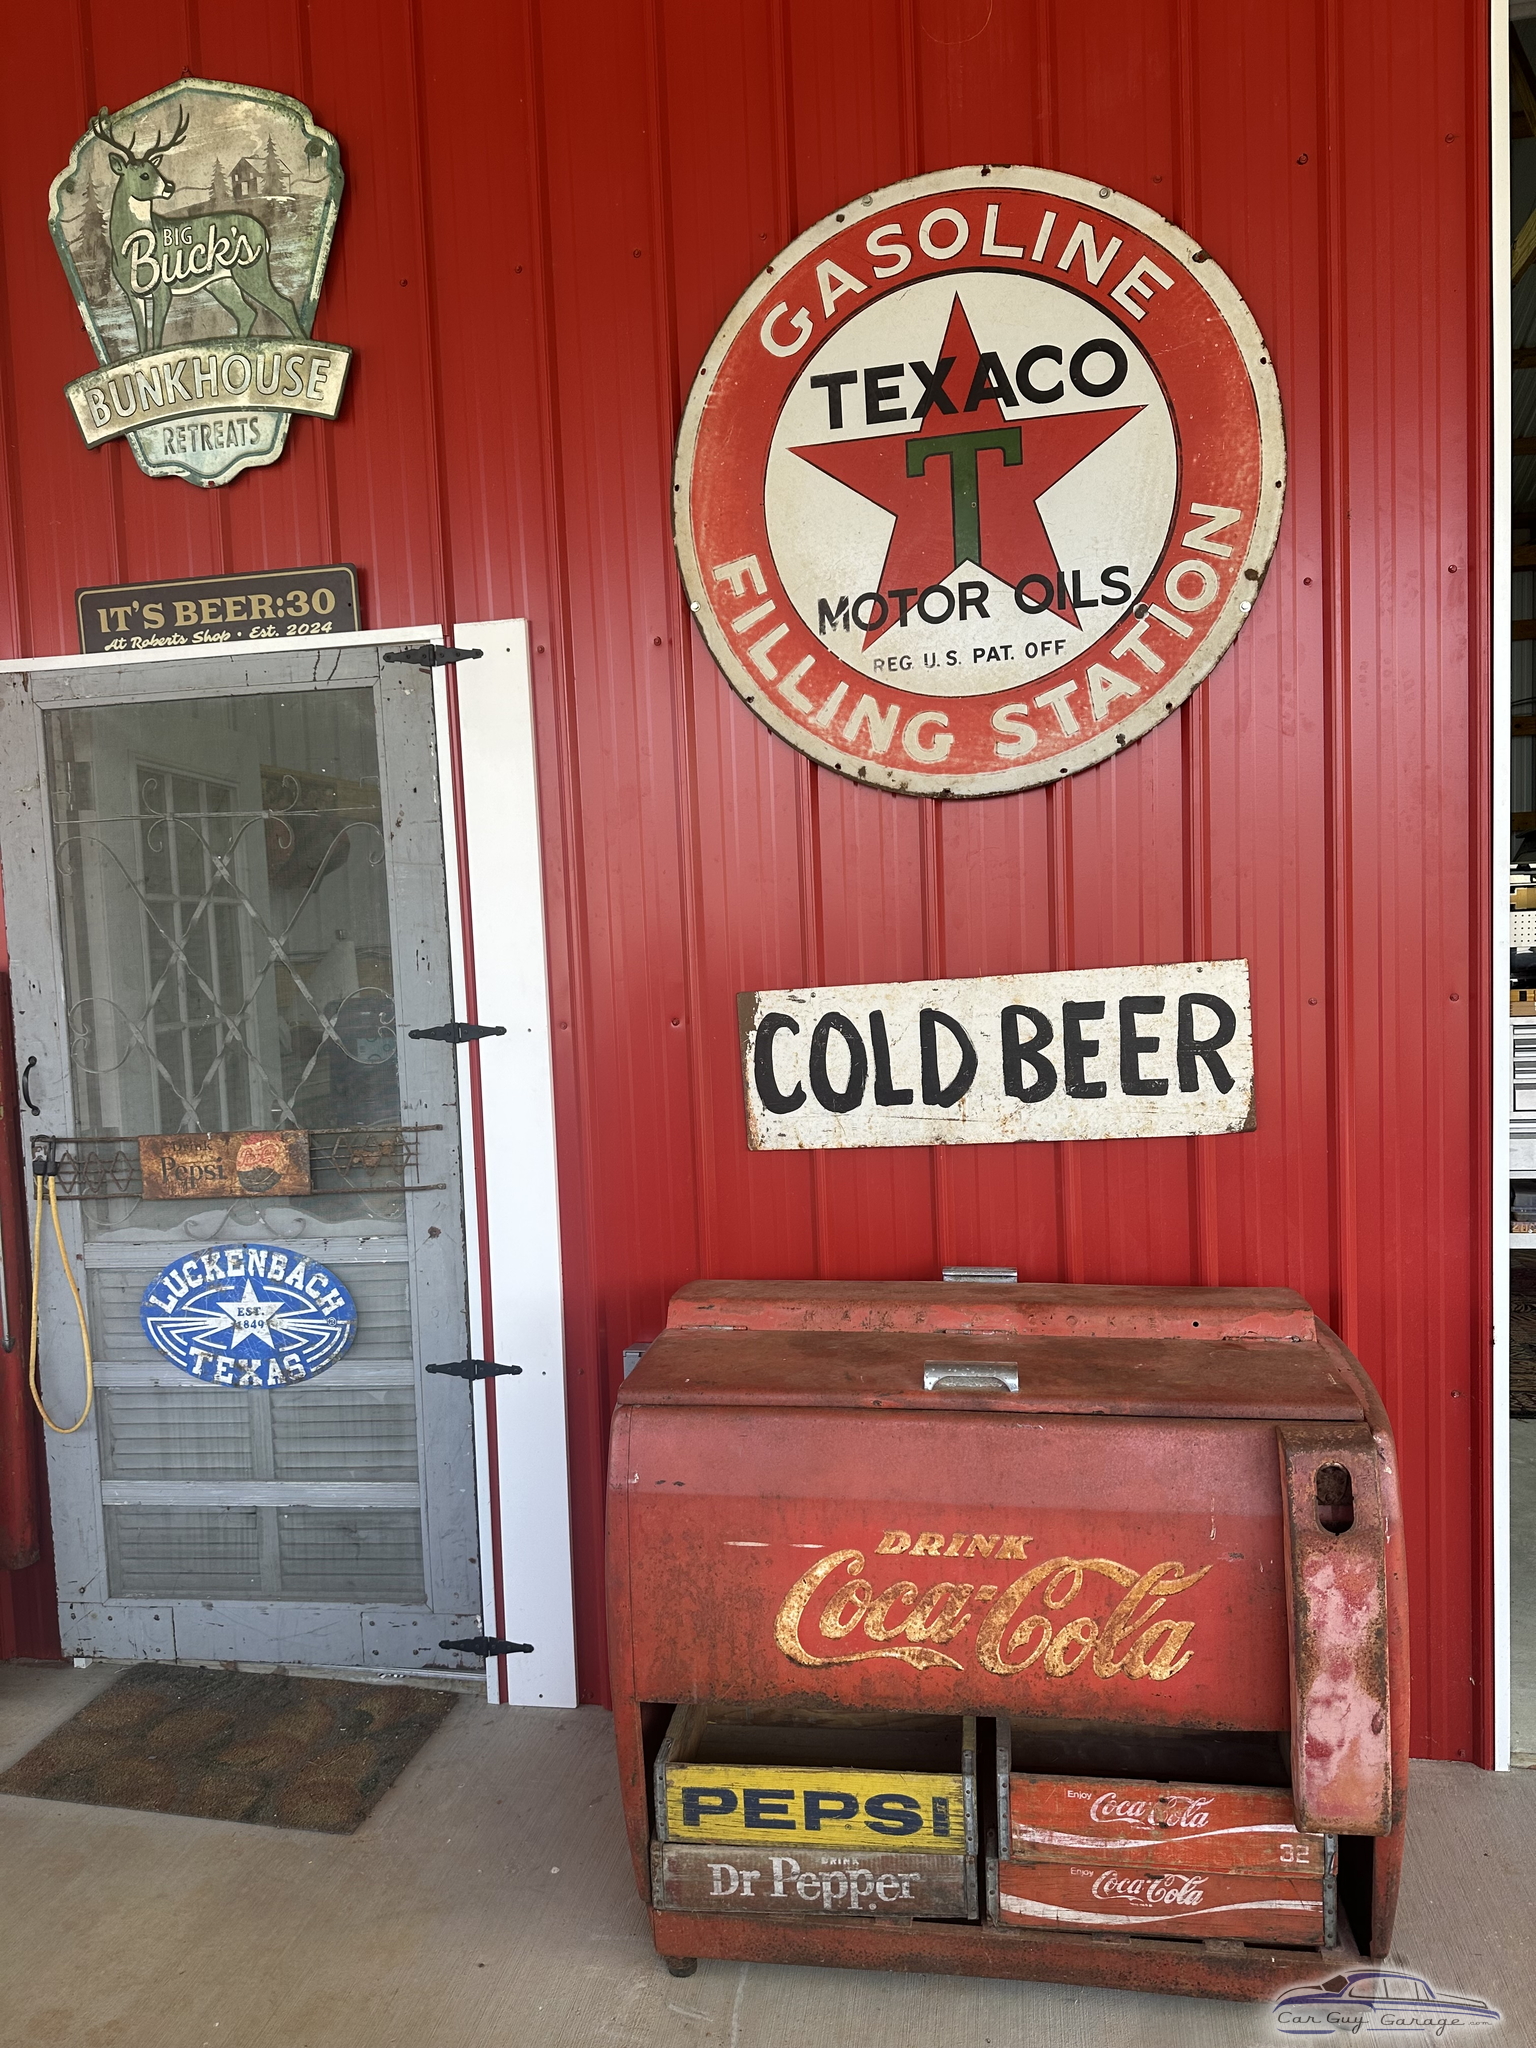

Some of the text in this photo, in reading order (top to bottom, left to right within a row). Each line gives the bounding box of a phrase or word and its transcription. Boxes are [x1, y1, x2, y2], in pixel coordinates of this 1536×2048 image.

[162, 226, 192, 247] BIG
[121, 224, 262, 294] Buck's
[759, 204, 1175, 359] GASOLINE
[85, 353, 331, 429] BUNKHOUSE
[810, 338, 1129, 430] TEXACO
[163, 417, 260, 456] RETREATS
[905, 426, 1023, 571] T
[97, 588, 336, 633] IT'S BEER:30
[817, 566, 1133, 637] MOTOR OILS
[104, 621, 333, 651] At Roberts Shop Est. 2024
[712, 502, 1243, 763] FILLING STATION
[973, 645, 1014, 663] PAT.
[1025, 639, 1067, 658] OFF
[755, 993, 1236, 1114] COLD BEER
[160, 1156, 227, 1189] Pepsi
[150, 1249, 345, 1316] LUCKENBACH
[237, 1307, 265, 1317] EST.
[238, 1320, 264, 1330] 1849
[188, 1347, 306, 1386] TEXAS
[874, 1530, 1034, 1560] DRINK
[774, 1549, 1213, 1680] Coca-Cola
[681, 1787, 950, 1837] PEPSI
[1067, 1789, 1092, 1801] Enjoy
[1090, 1792, 1215, 1828] Coca-Cola
[821, 1857, 859, 1865] DRINK
[1070, 1866, 1094, 1877] Enjoy
[1279, 1843, 1310, 1863] 32
[707, 1856, 921, 1910] Dr Pepper
[1092, 1869, 1209, 1906] Coca-Cola
